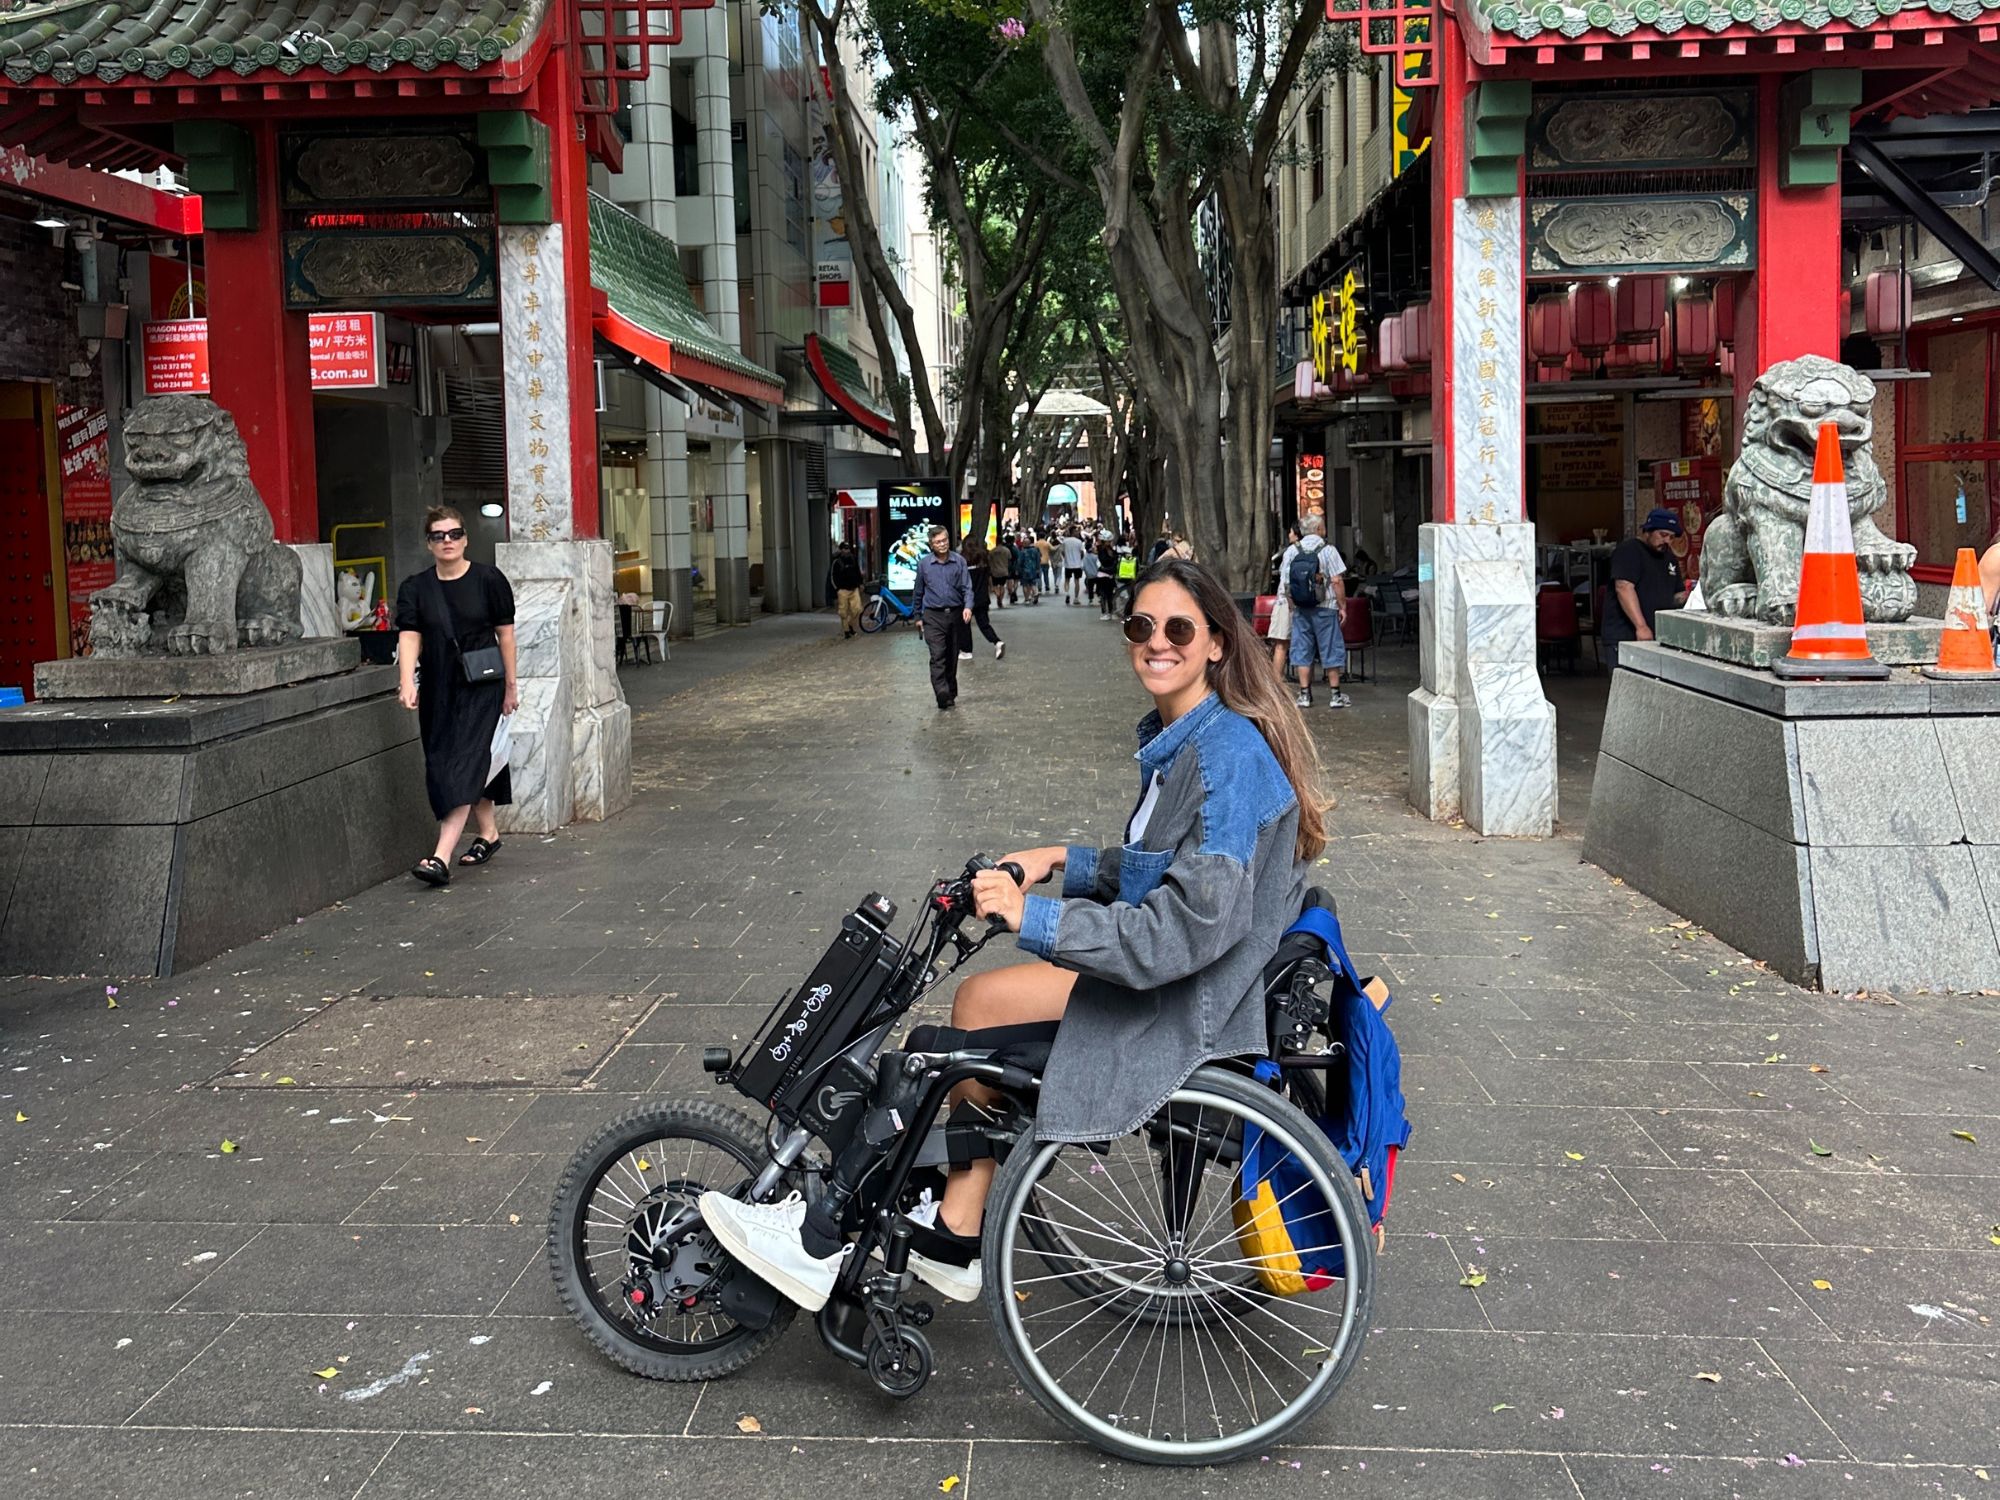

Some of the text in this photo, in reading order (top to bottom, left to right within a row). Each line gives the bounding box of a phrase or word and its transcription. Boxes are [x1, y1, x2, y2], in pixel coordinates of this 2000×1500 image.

[819, 264, 840, 272] RETAIL
[147, 325, 177, 333] DRAGON
[333, 334, 367, 348] 平方米
[311, 368, 368, 380] 8.com.au
[1554, 461, 1606, 472] UPSTAIRS
[889, 496, 943, 508] MALEVO
